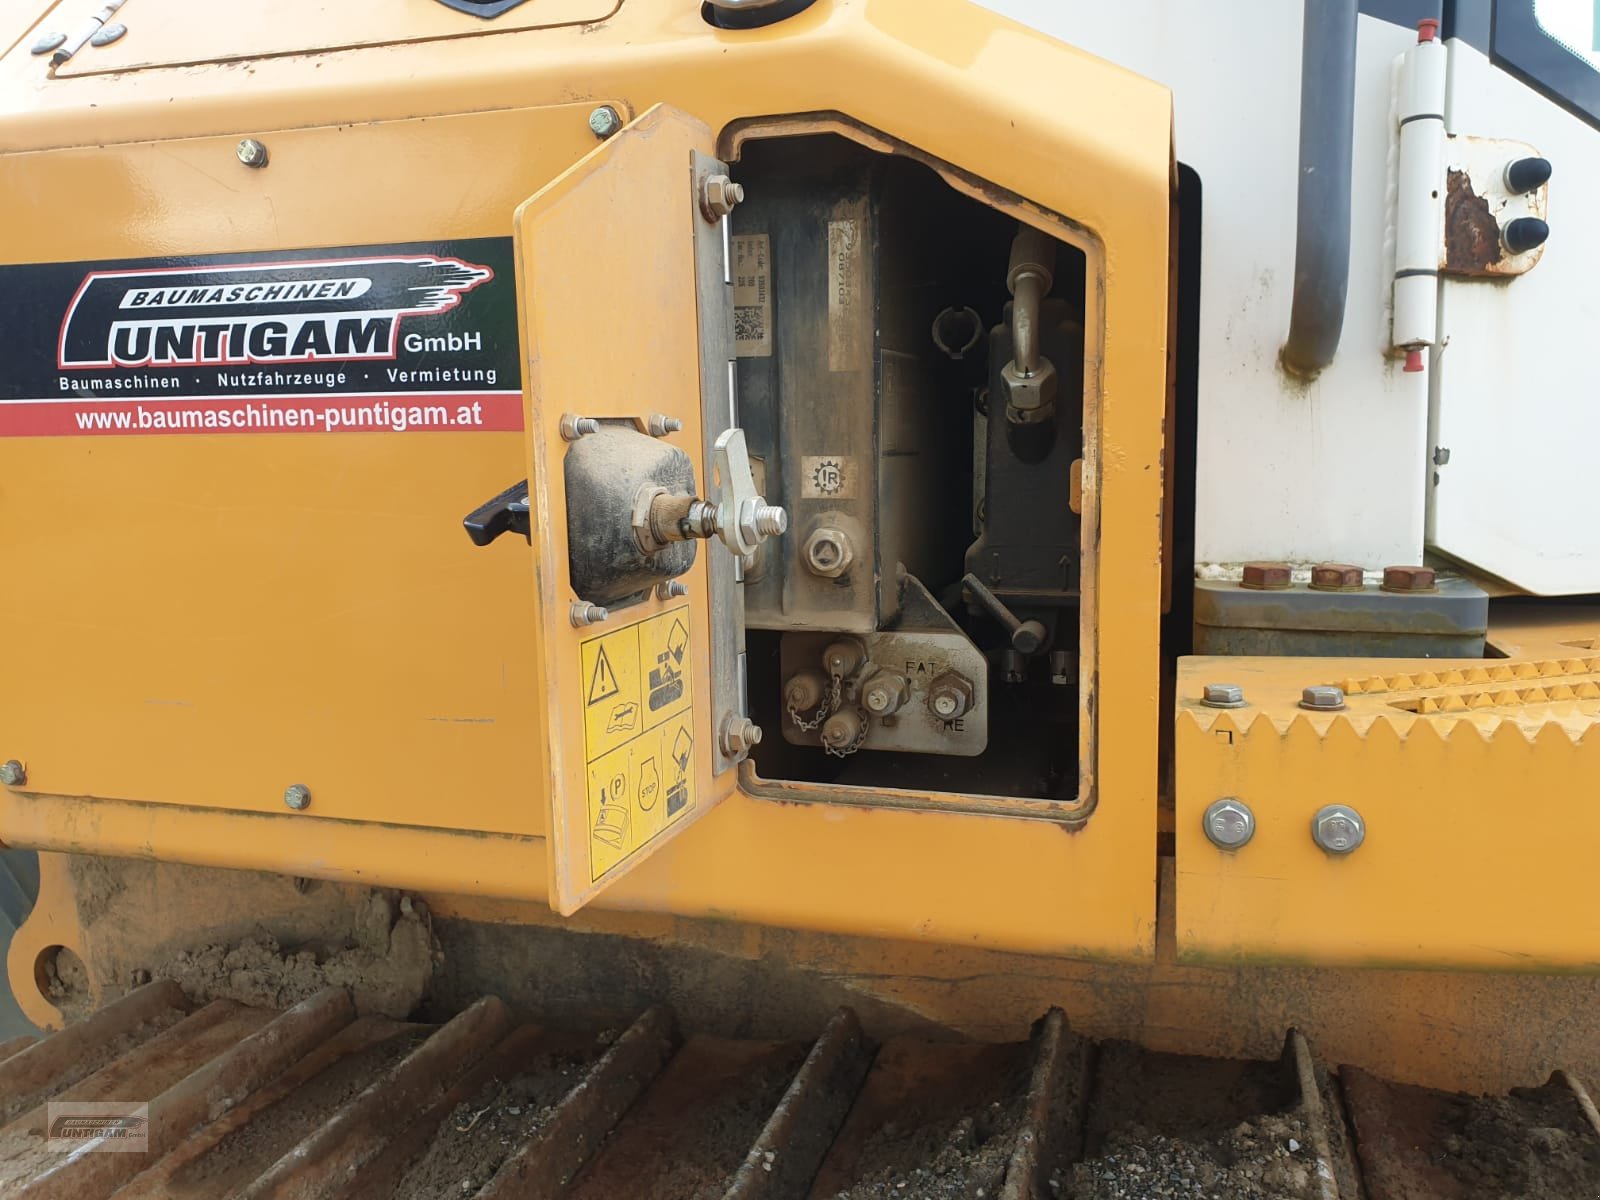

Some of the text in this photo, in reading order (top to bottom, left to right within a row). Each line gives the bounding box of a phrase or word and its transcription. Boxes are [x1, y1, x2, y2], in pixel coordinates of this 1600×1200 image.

[131, 281, 356, 306] BAUMASCHINEN
[404, 332, 481, 354] GmbH
[59, 367, 497, 390] Baumaschinen Nutzfahrzeuge Vermietung
[75, 401, 482, 431] www.baumaschinen-puntigam.at
[905, 661, 937, 675] FAT
